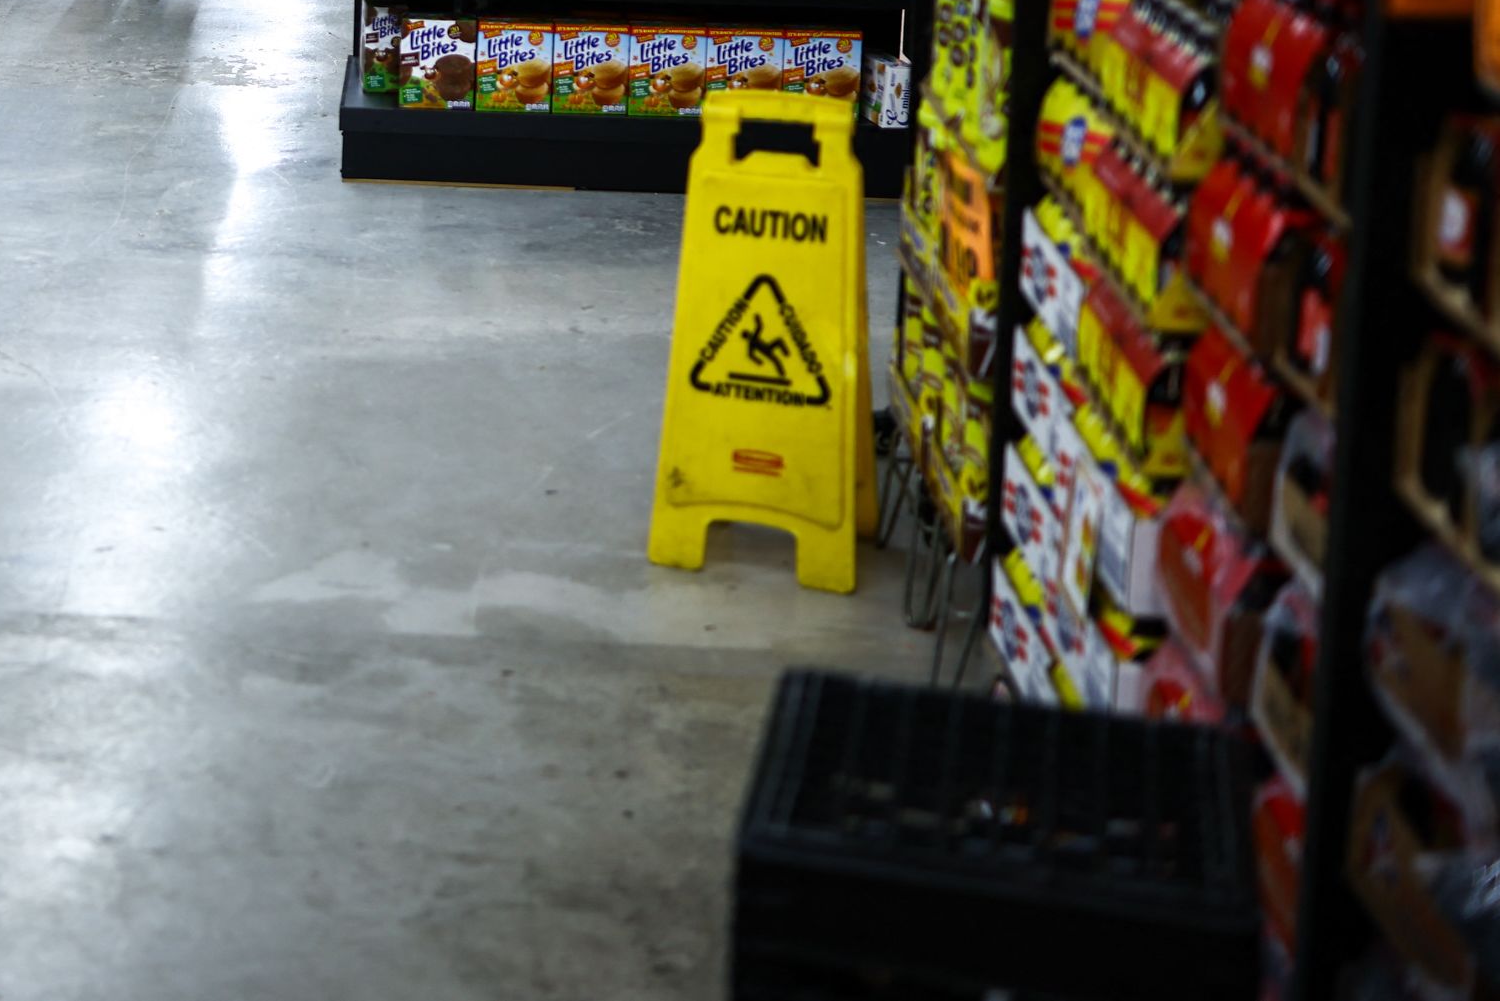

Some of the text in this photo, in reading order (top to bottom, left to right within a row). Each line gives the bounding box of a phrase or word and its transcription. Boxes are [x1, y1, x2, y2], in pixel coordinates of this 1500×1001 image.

[410, 25, 445, 50] Little
[488, 34, 523, 58] Little
[564, 35, 599, 60] Little
[421, 41, 457, 60] Bites
[498, 49, 536, 69] Bites
[575, 50, 612, 71] Bites
[640, 38, 676, 63] Little
[716, 39, 753, 65] Little
[794, 41, 831, 67] Little
[651, 53, 689, 73] Bites
[728, 55, 766, 75] Bites
[805, 56, 844, 77] Bites
[713, 205, 829, 243] CAUTION
[700, 299, 748, 362] CAUTION
[779, 304, 823, 375] CUIDADO
[711, 382, 806, 406] ATTENTION
